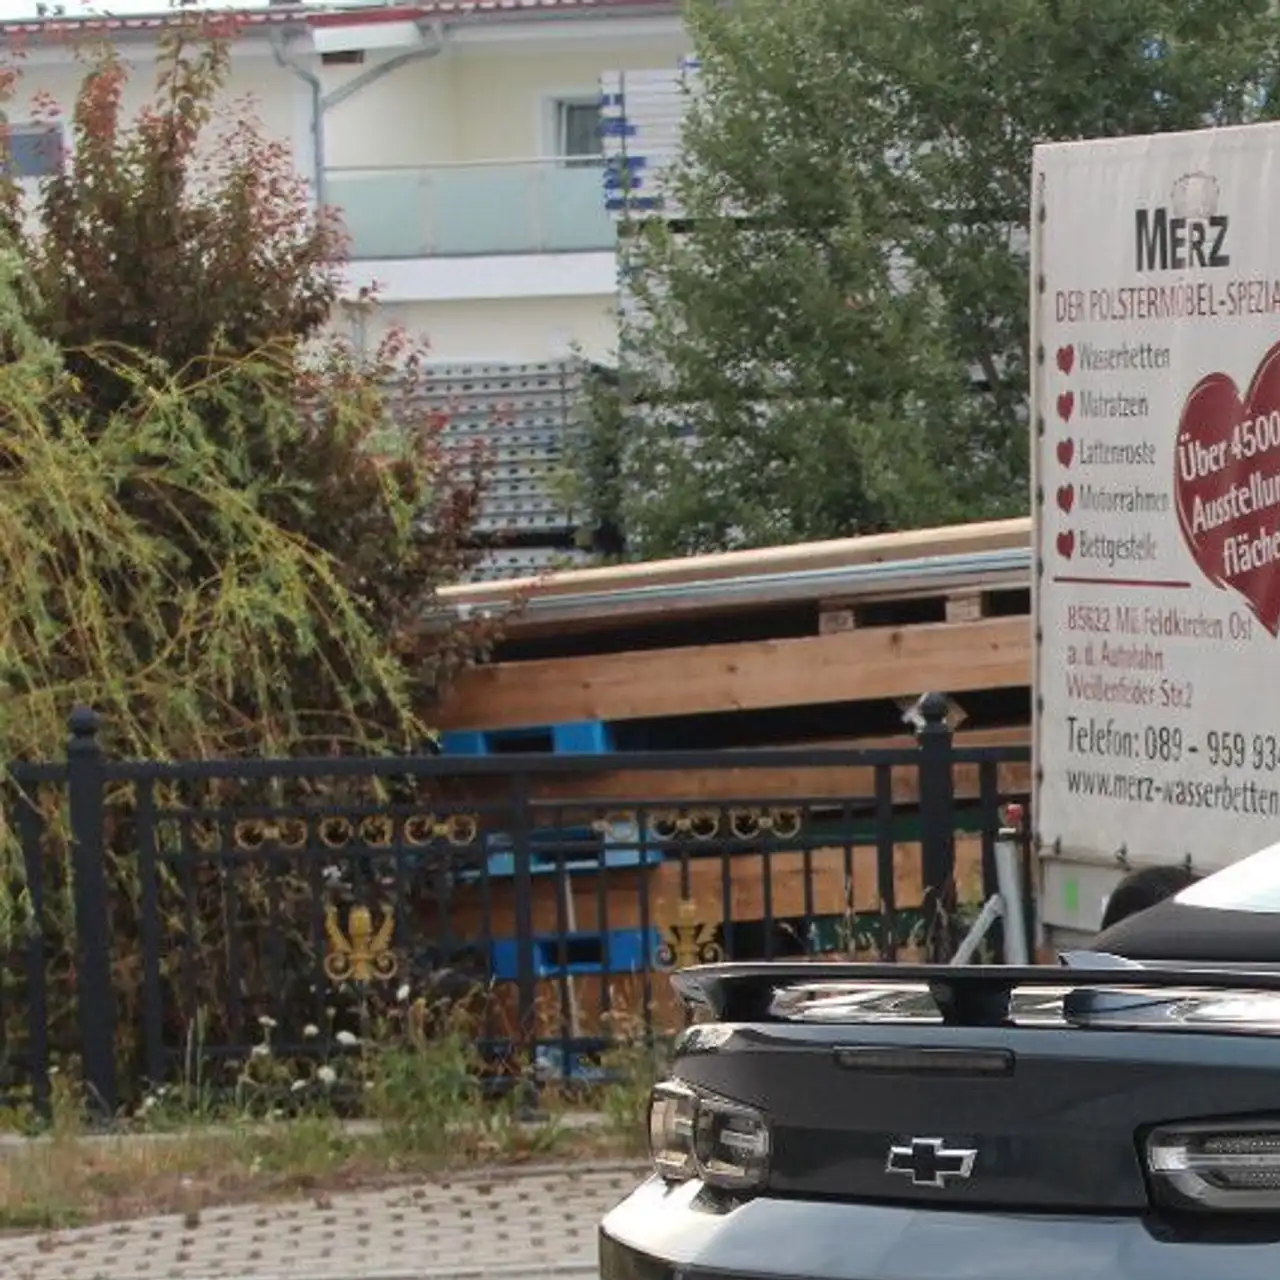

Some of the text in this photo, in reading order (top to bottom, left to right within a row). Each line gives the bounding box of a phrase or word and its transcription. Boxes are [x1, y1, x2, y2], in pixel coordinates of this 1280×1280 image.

[1135, 207, 1230, 271] MERZ
[1056, 289, 1085, 322] DER
[1179, 432, 1228, 481] Über
[1067, 716, 1139, 758] Telefon:
[1145, 726, 1182, 761] 089
[1207, 730, 1245, 768] 959
